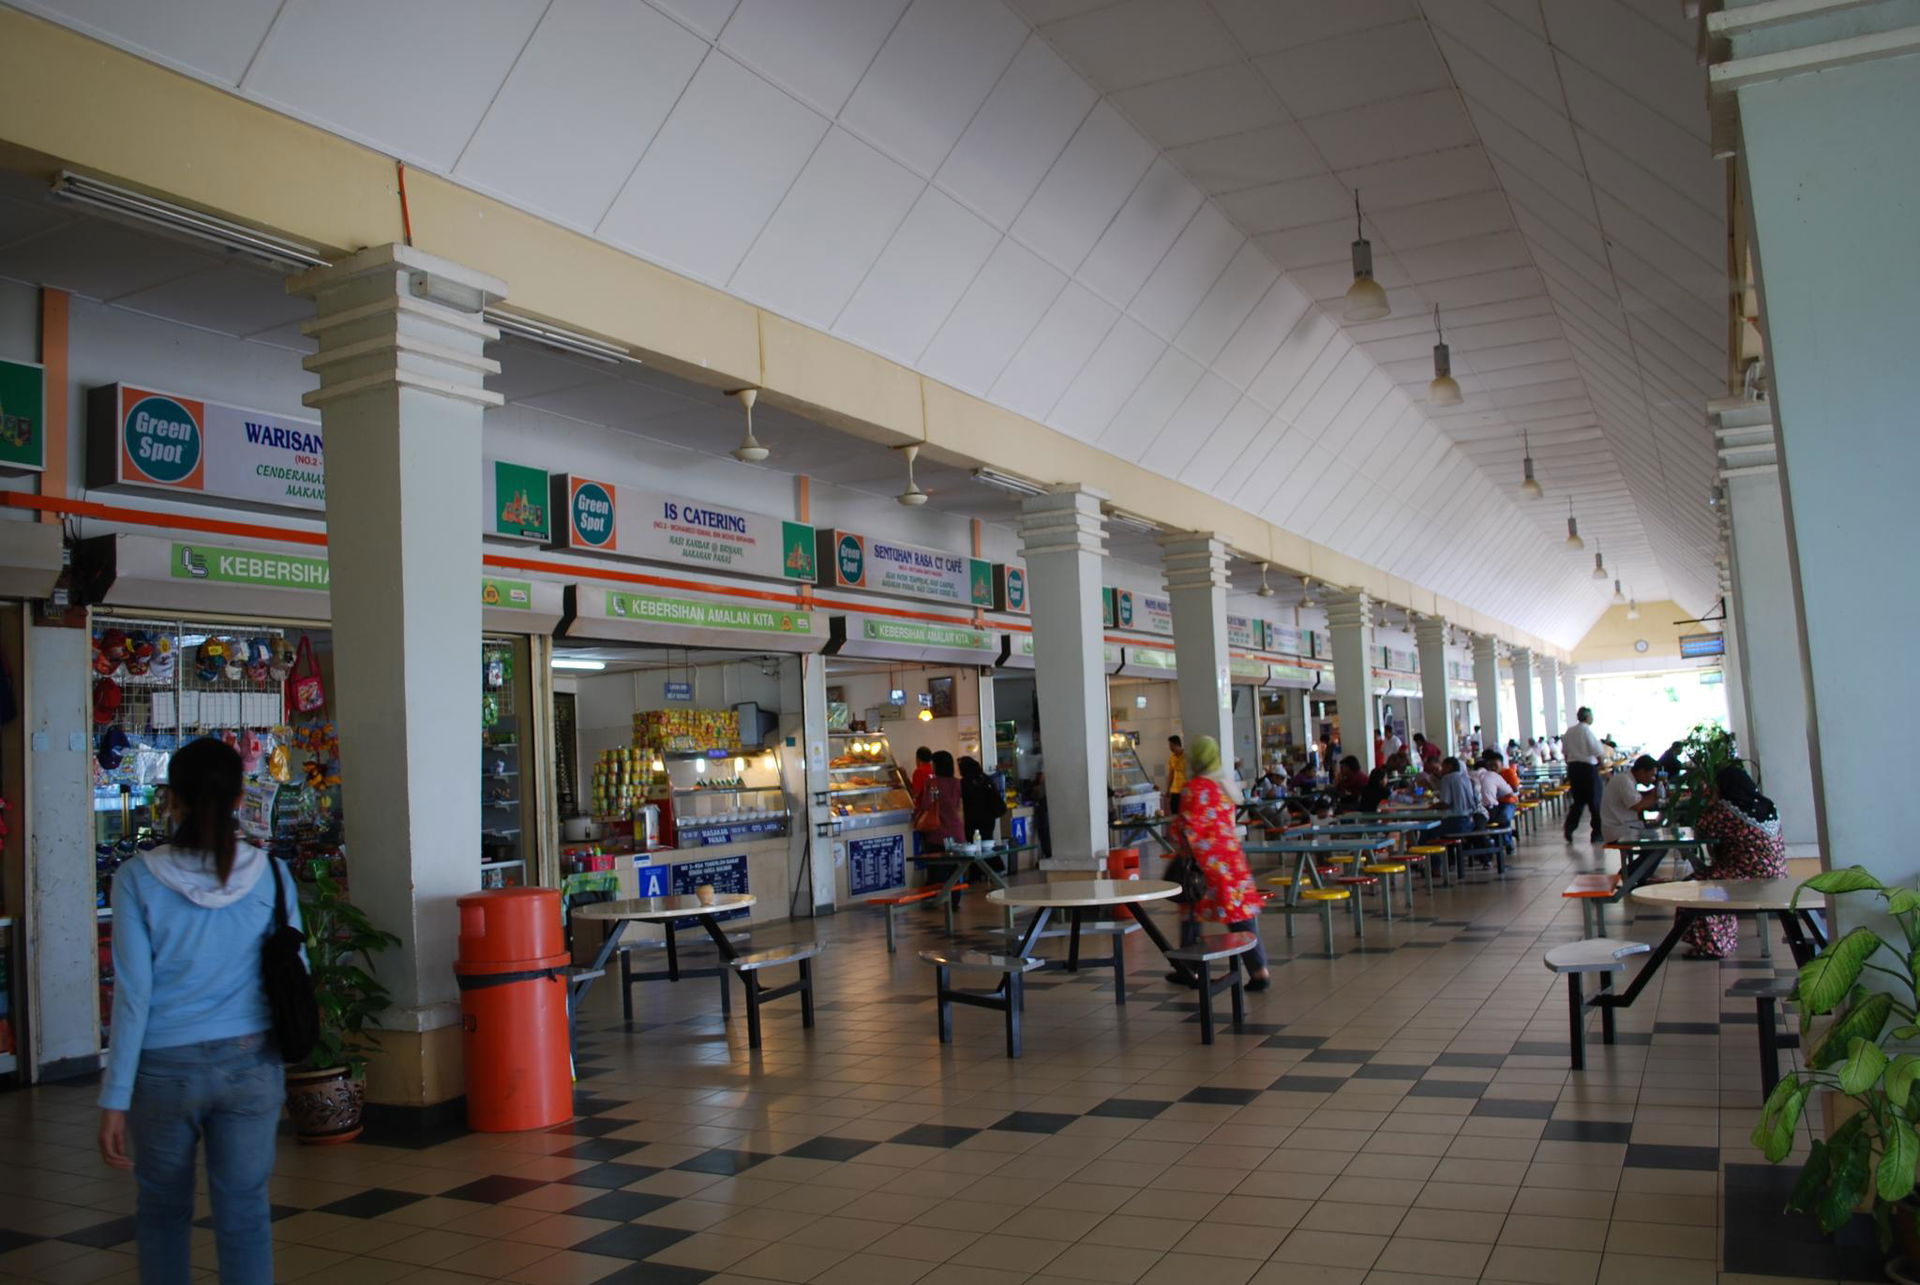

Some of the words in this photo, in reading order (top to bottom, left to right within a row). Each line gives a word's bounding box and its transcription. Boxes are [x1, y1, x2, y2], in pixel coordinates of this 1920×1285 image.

[136, 411, 191, 441] Green
[139, 436, 182, 464] Spot
[578, 494, 609, 515] Green
[580, 512, 604, 532] Spot
[664, 502, 678, 521] IS
[683, 506, 746, 534] CATERING
[840, 544, 860, 560] Green
[874, 544, 912, 566] SENTUHAN
[914, 552, 933, 568] RASA
[843, 558, 858, 574] Spot
[632, 599, 705, 621] KEBERSIHAN
[708, 607, 751, 625] AMALAN
[753, 613, 775, 627] KITA
[648, 875, 661, 896] A
